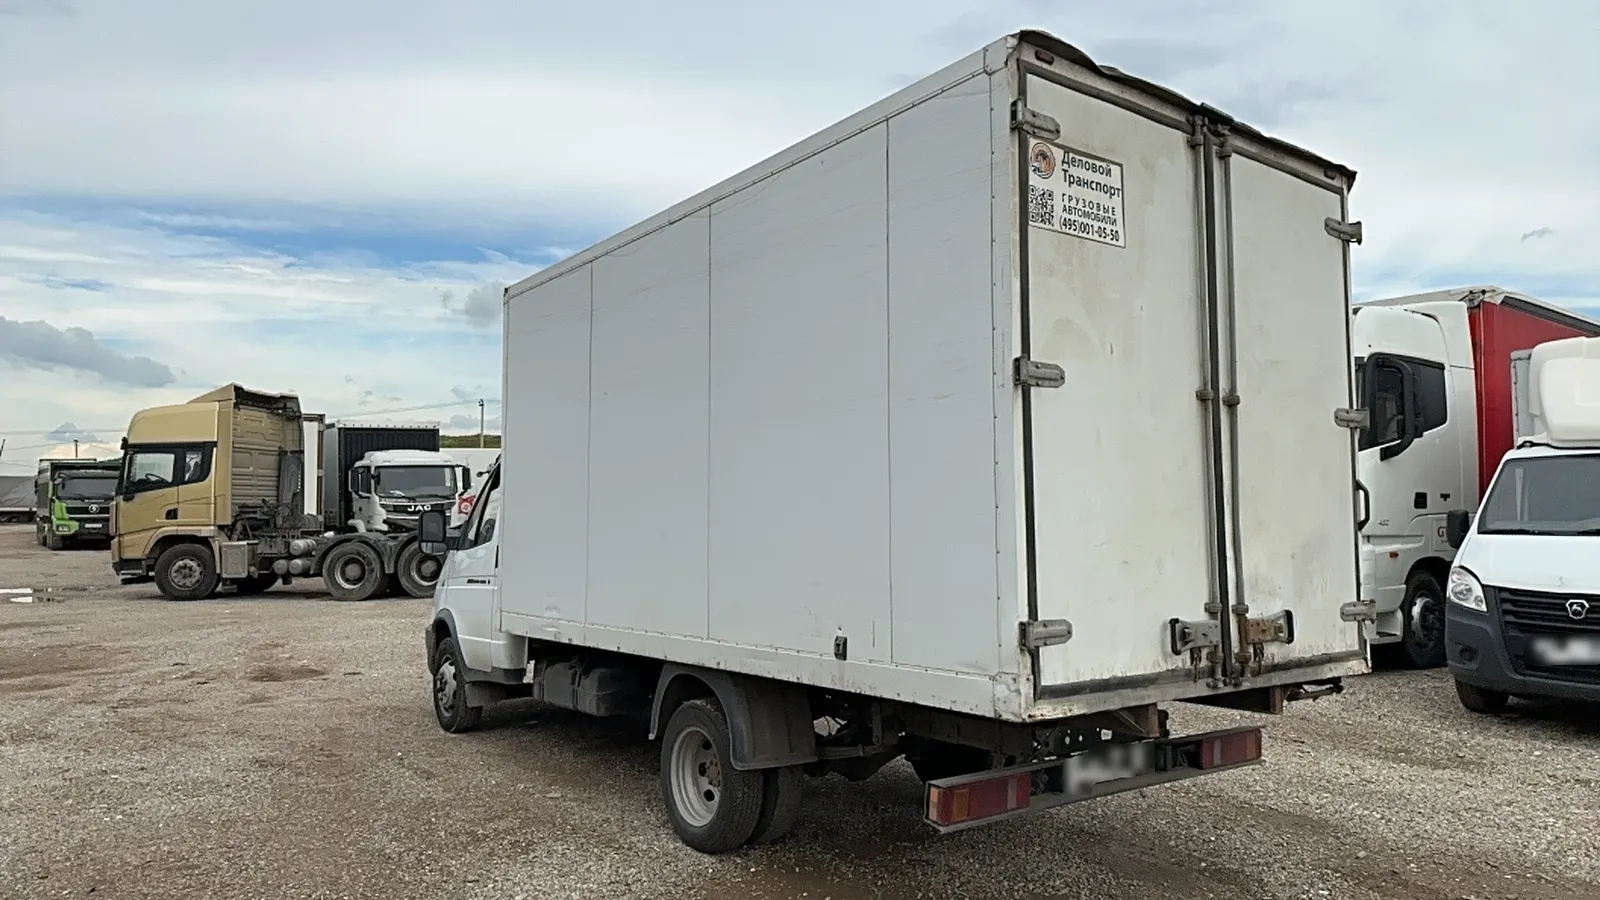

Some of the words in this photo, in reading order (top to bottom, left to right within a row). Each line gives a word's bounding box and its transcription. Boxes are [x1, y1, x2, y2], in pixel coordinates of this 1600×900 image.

[1061, 151, 1112, 178] Деловой
[1061, 168, 1121, 199] Транспорт
[1061, 193, 1116, 216] ГРУЗОВЫЕ
[1062, 204, 1117, 227] АВТОМОБИЛИ
[1060, 215, 1119, 242] (495)001-05-50
